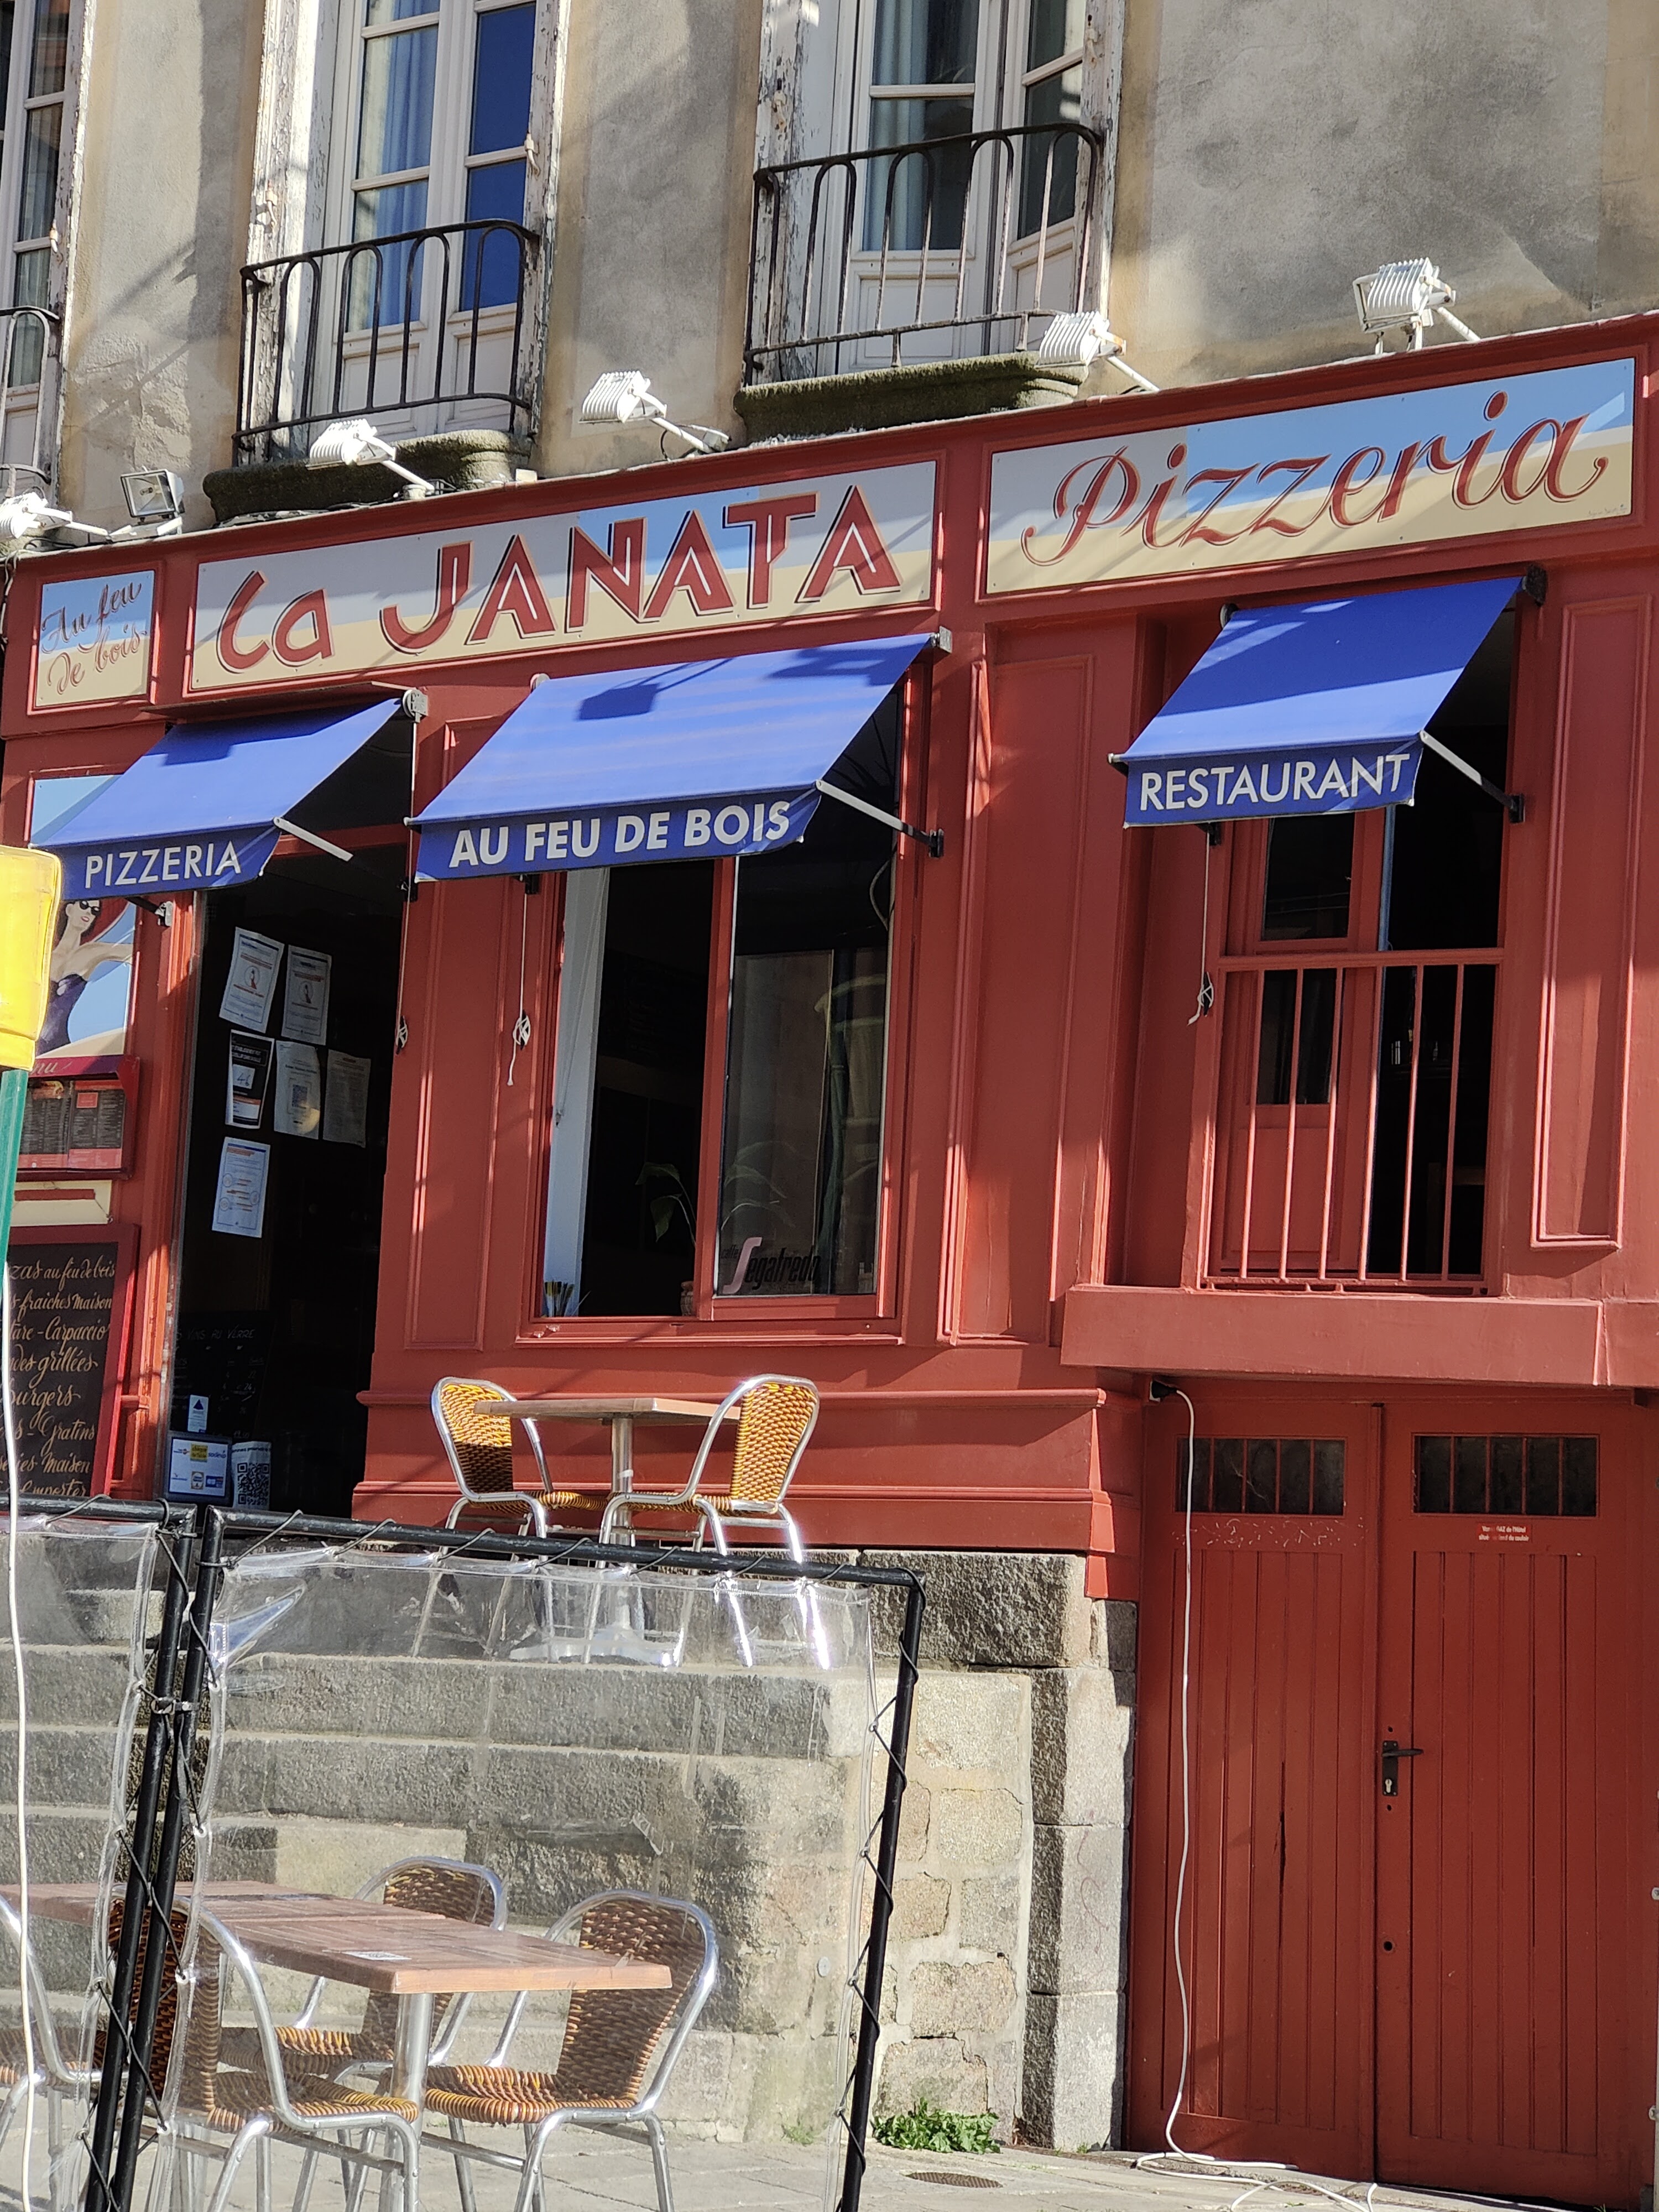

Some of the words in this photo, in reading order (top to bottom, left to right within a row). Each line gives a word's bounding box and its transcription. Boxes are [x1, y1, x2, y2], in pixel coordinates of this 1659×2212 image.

[1021, 390, 1609, 566] Pizzeria
[379, 485, 902, 655] JANATA
[77, 582, 142, 653] feu
[95, 622, 147, 672] bois
[1140, 753, 1411, 811] RESTAURANT
[448, 826, 509, 868] AU
[524, 818, 601, 862] FEU
[614, 811, 671, 854] DE
[684, 800, 791, 847] BOIS
[85, 841, 242, 889] PIZZERIA
[10, 1260, 43, 1280] zas
[722, 1237, 821, 1294] Segafredo
[11, 1319, 33, 1340] tare
[45, 1316, 111, 1355] Carpaccio
[29, 1346, 98, 1389] grillées
